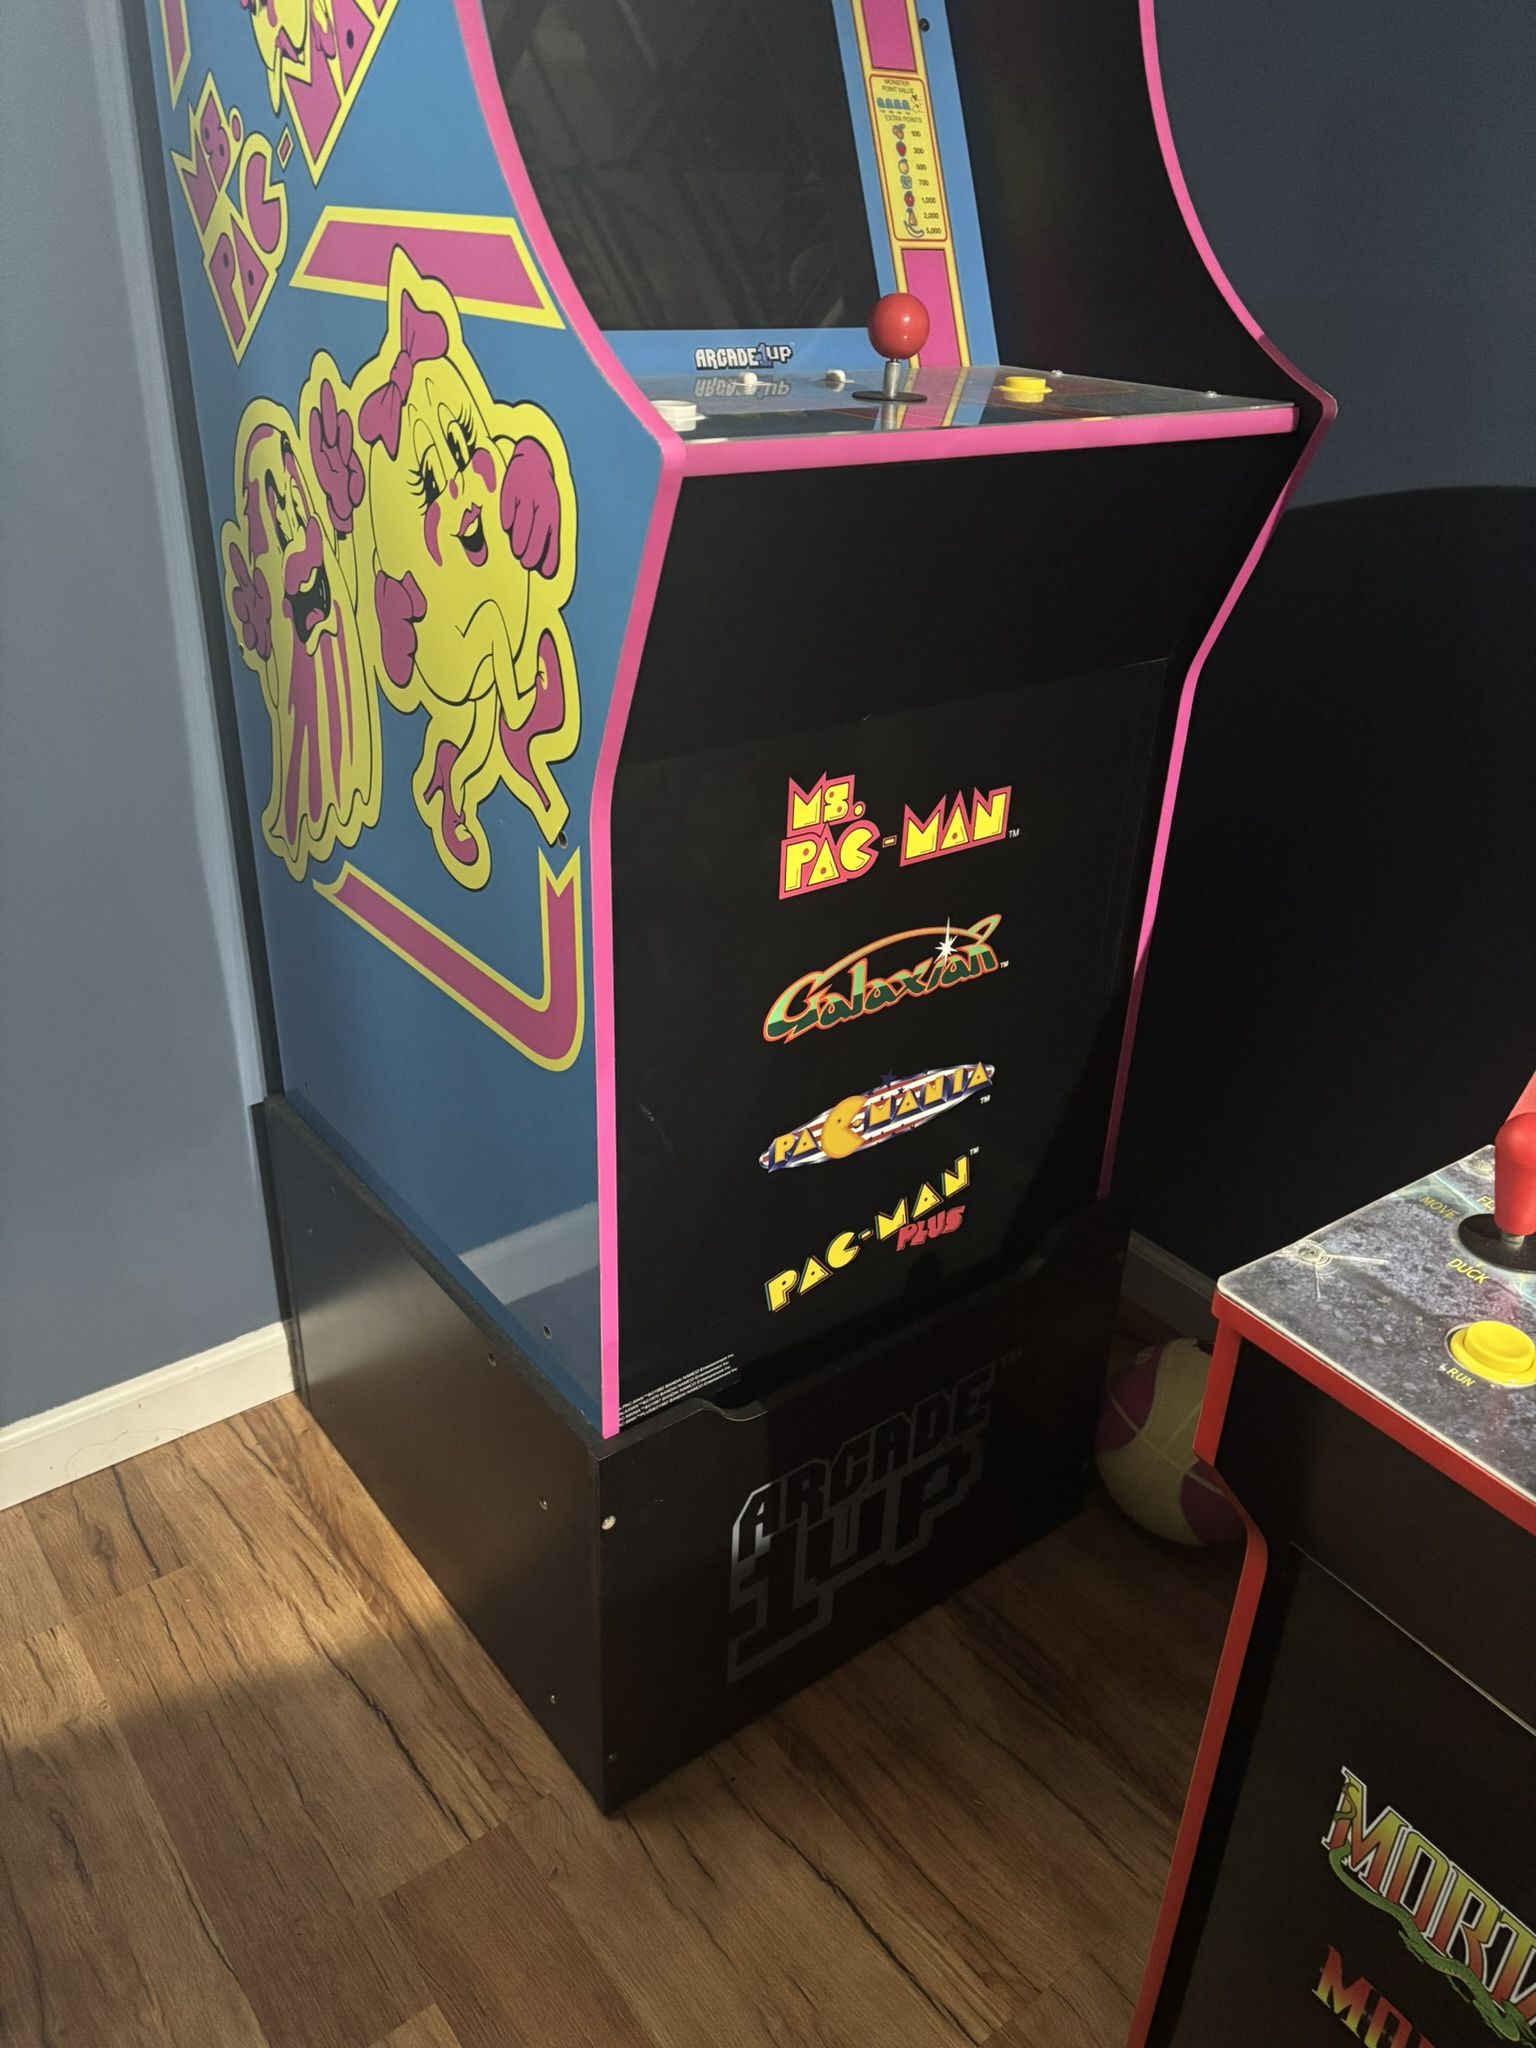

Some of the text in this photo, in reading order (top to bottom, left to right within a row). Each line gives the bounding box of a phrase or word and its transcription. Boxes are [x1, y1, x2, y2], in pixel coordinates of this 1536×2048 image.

[1421, 1195, 1461, 1219] MOVE
[896, 1205, 966, 1252] PLUS
[1447, 1258, 1491, 1284] DUCK
[1446, 1367, 1476, 1387] RUN
[731, 1361, 996, 1564] ARCADE
[1321, 1765, 1536, 2028] MORT
